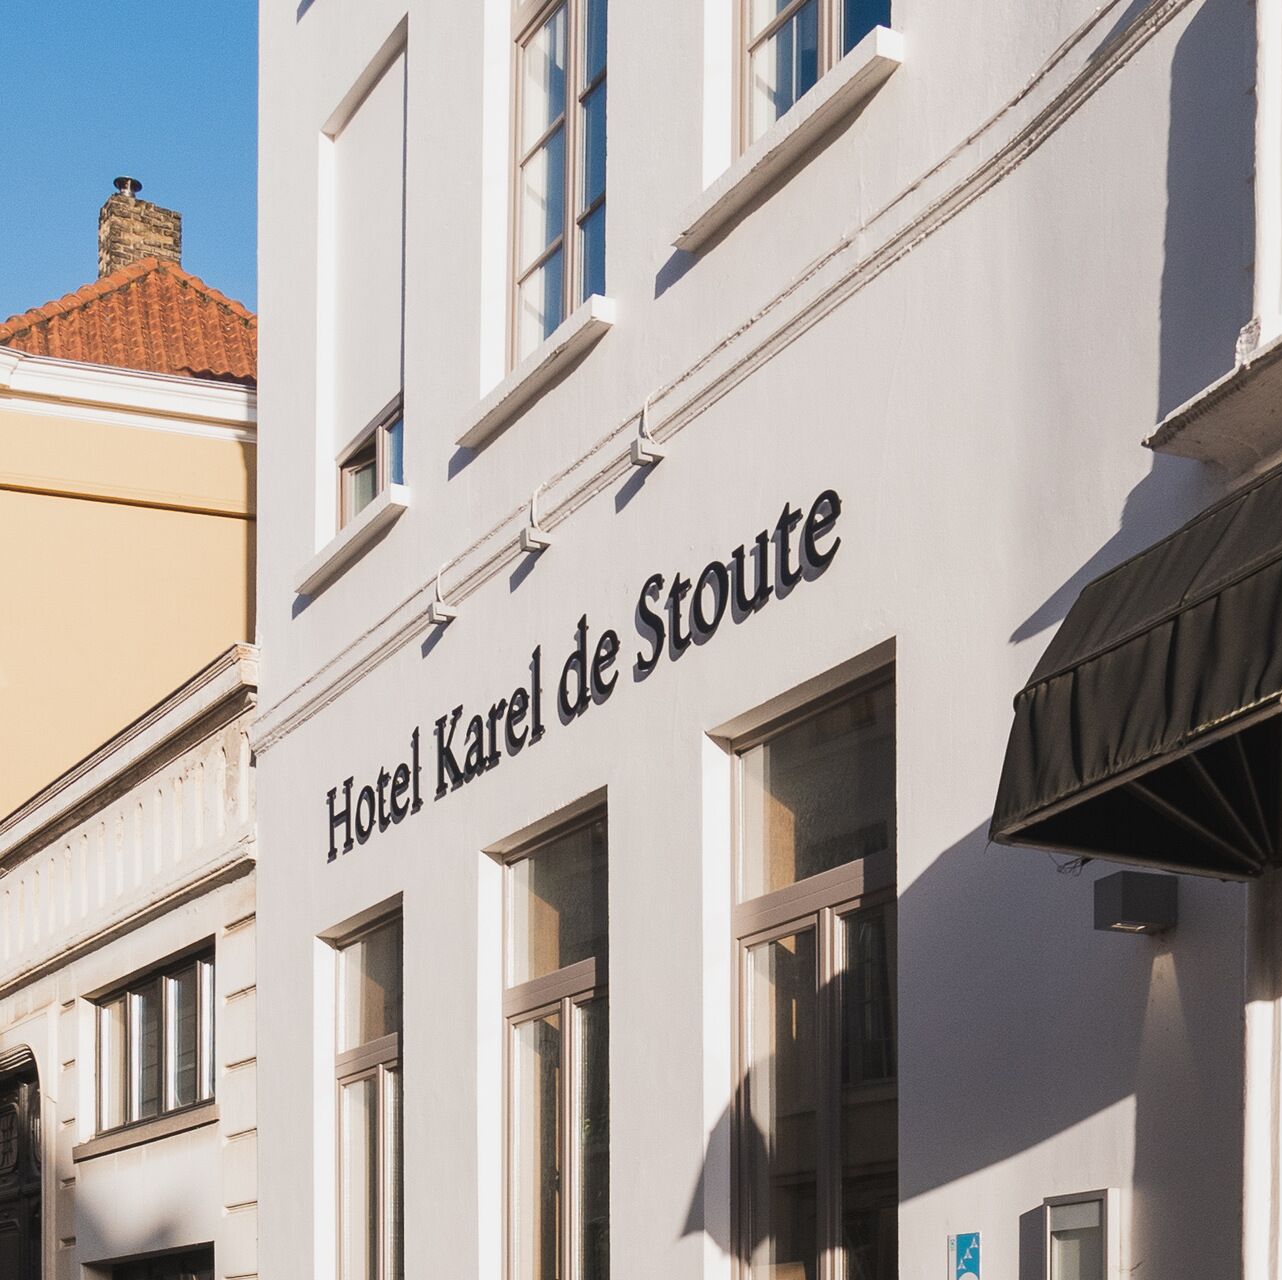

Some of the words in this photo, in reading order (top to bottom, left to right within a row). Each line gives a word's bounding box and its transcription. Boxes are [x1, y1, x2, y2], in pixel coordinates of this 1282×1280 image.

[326, 726, 422, 861] Hotel
[434, 645, 545, 800] Karel
[558, 614, 620, 724] de
[634, 489, 842, 678] Stoute
